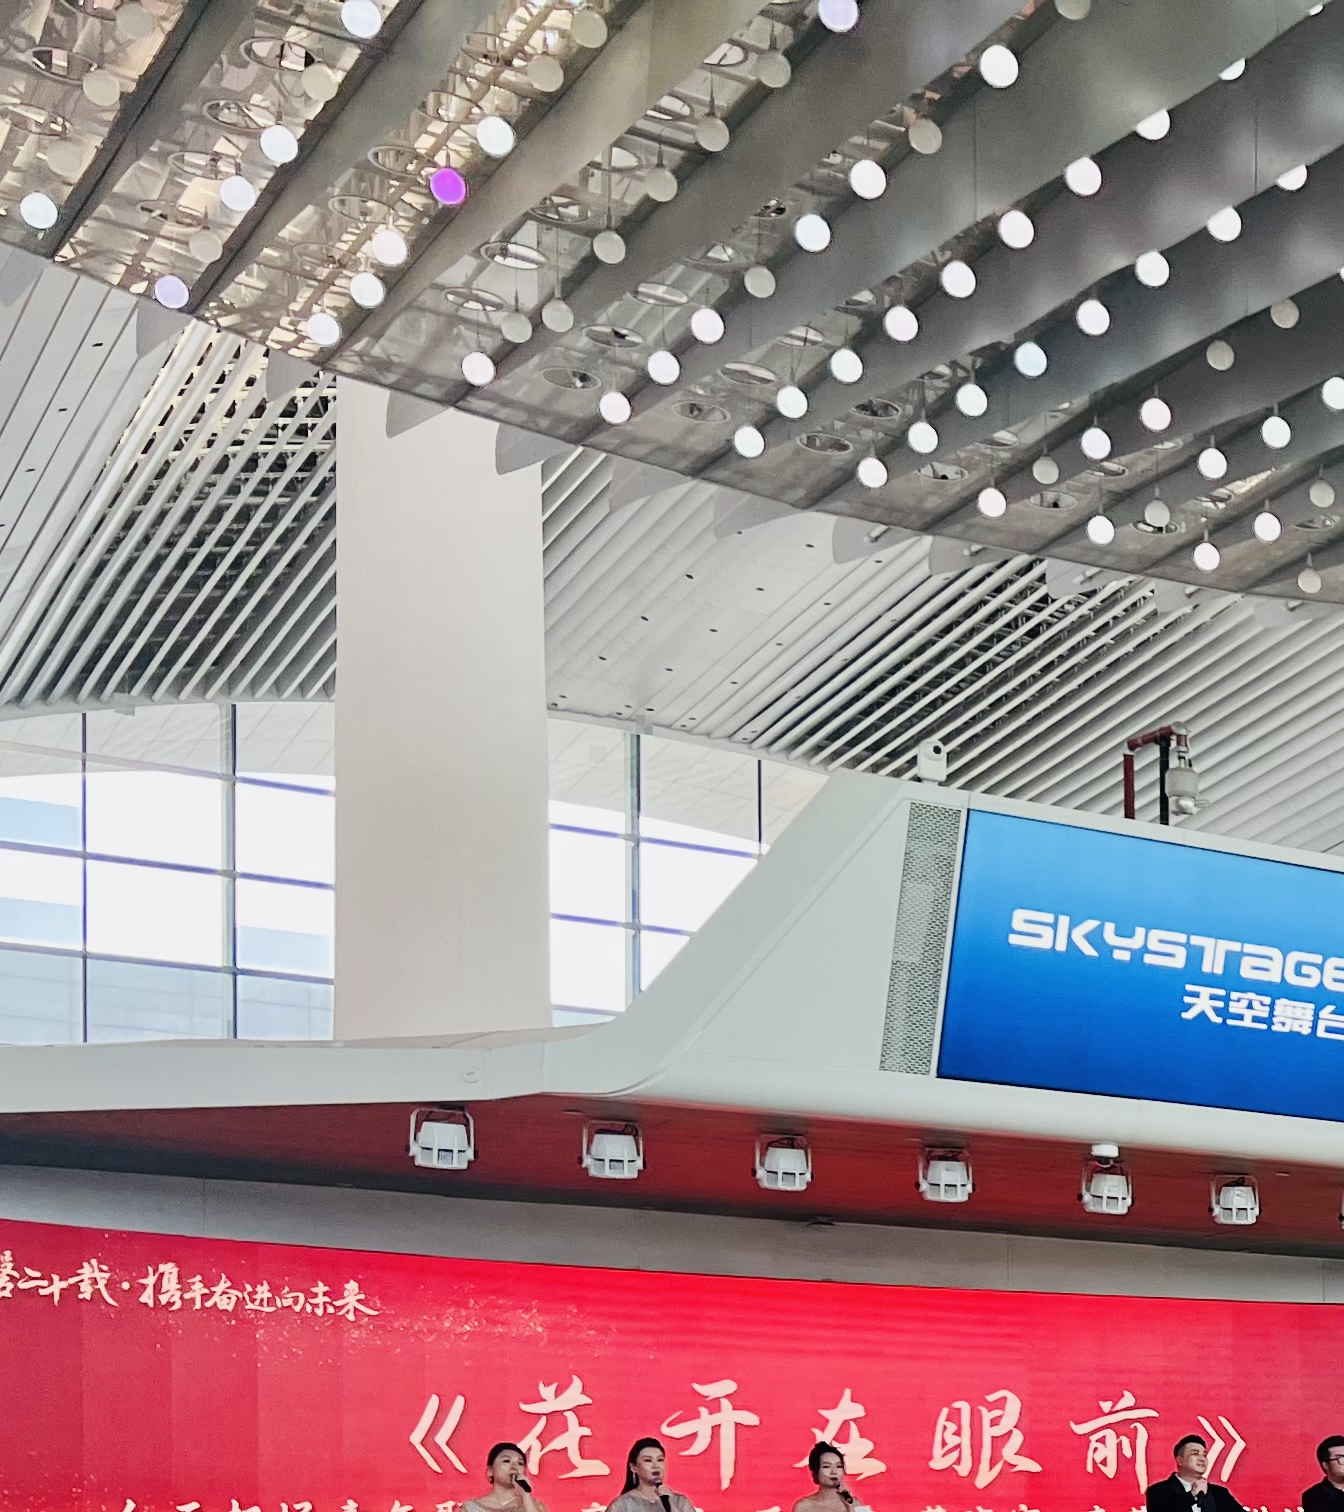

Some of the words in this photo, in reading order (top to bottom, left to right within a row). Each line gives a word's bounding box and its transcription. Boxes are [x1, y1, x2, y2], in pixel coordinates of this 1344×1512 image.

[408, 1375, 1248, 1493] 《花开在眼前》
